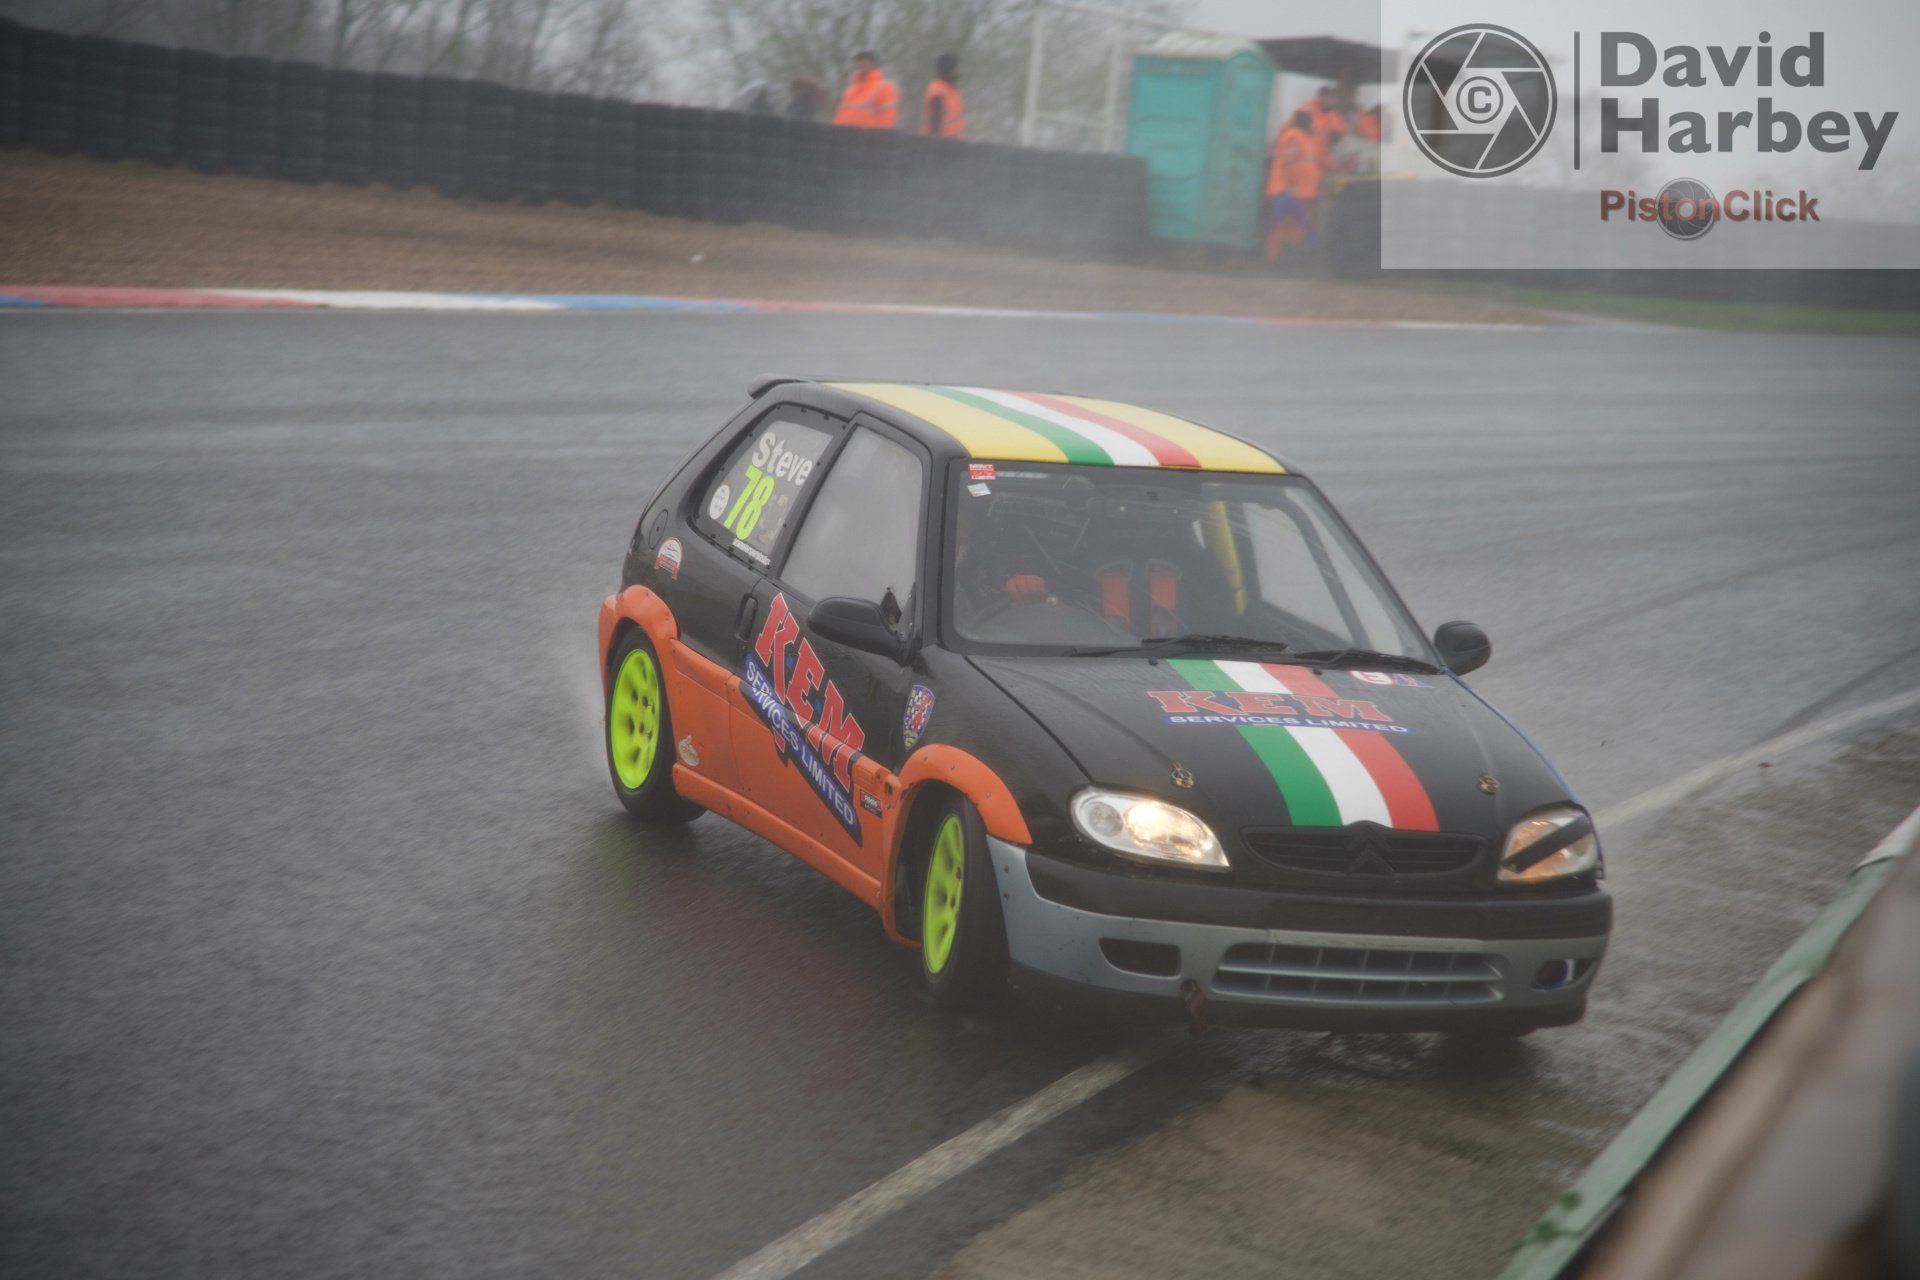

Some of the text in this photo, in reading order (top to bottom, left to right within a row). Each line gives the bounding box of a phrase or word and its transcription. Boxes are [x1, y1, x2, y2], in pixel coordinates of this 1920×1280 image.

[751, 432, 813, 486] Steve
[723, 464, 775, 540] 78
[755, 592, 865, 793] KEM
[1146, 690, 1395, 723] KEM
[1168, 715, 1408, 734] SERVICES LIMITED
[746, 661, 854, 825] SERVICES LIMITED
